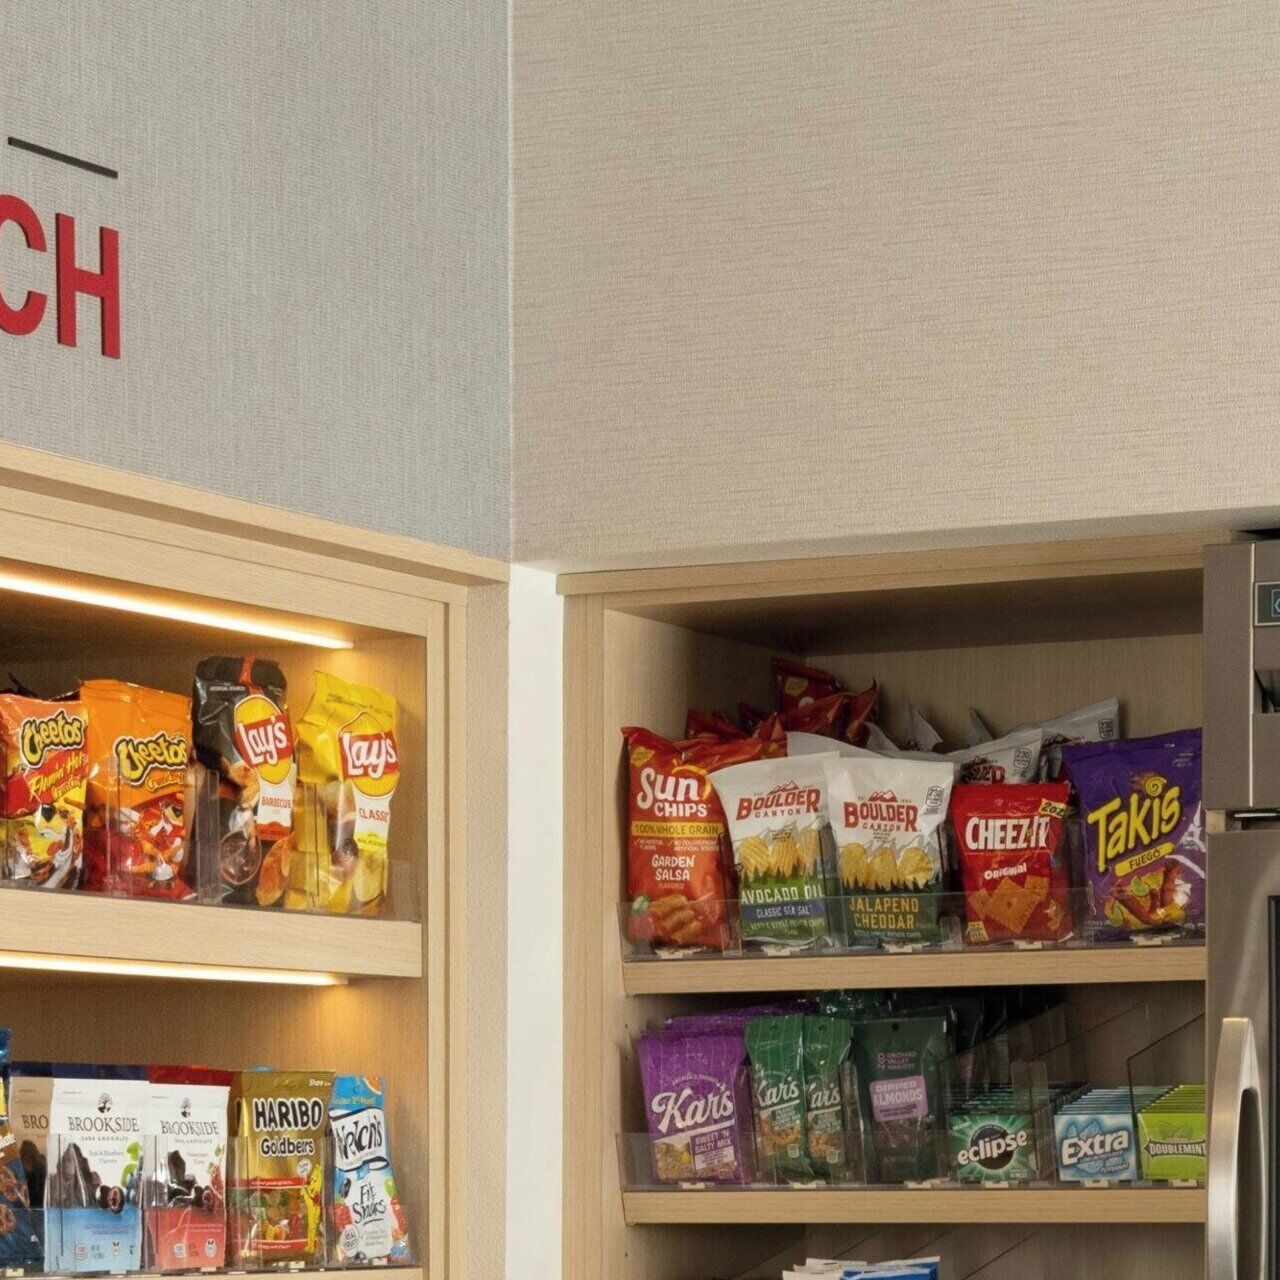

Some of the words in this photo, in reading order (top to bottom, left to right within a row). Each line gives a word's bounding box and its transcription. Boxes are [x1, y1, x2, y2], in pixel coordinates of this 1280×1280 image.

[21, 709, 85, 768] Cheetos
[237, 711, 293, 765] Lay's
[115, 731, 188, 785] Cheetos
[339, 730, 398, 779] Lay's
[637, 767, 700, 809] Sun
[260, 795, 293, 809] BARBECUE
[654, 802, 708, 818] CHIPS
[736, 787, 822, 821] BOULDER
[755, 809, 801, 819] CANYON
[844, 802, 919, 832] BOULDER
[634, 823, 654, 835] 100%
[655, 823, 687, 835] WHOLE
[688, 824, 720, 835] GRAIN
[863, 821, 901, 831] CANYON
[1087, 786, 1180, 873] Takis
[651, 854, 696, 868] GARDEN
[1128, 849, 1161, 870] FUEGO
[655, 868, 691, 881] SALSA
[741, 888, 798, 905] AVOCADO
[756, 907, 782, 918] CLASSIC
[854, 915, 915, 928] CHEDDAR
[874, 1080, 917, 1091] DIPPED
[873, 1089, 923, 1105] ALMONDS
[253, 1098, 324, 1131] HARIBO
[651, 1082, 734, 1134] Kar's
[67, 1116, 140, 1133] BROOKSIDE
[161, 1120, 220, 1135] BROOKSIDE
[694, 1132, 720, 1145] SWEET
[694, 1141, 716, 1154] SALTY
[716, 1138, 732, 1150] MIX
[260, 1137, 315, 1158] Goldbears
[957, 1130, 1028, 1166] eclipse
[1061, 1130, 1129, 1166] Extra
[1149, 1143, 1206, 1156] DOUBLEMINT
